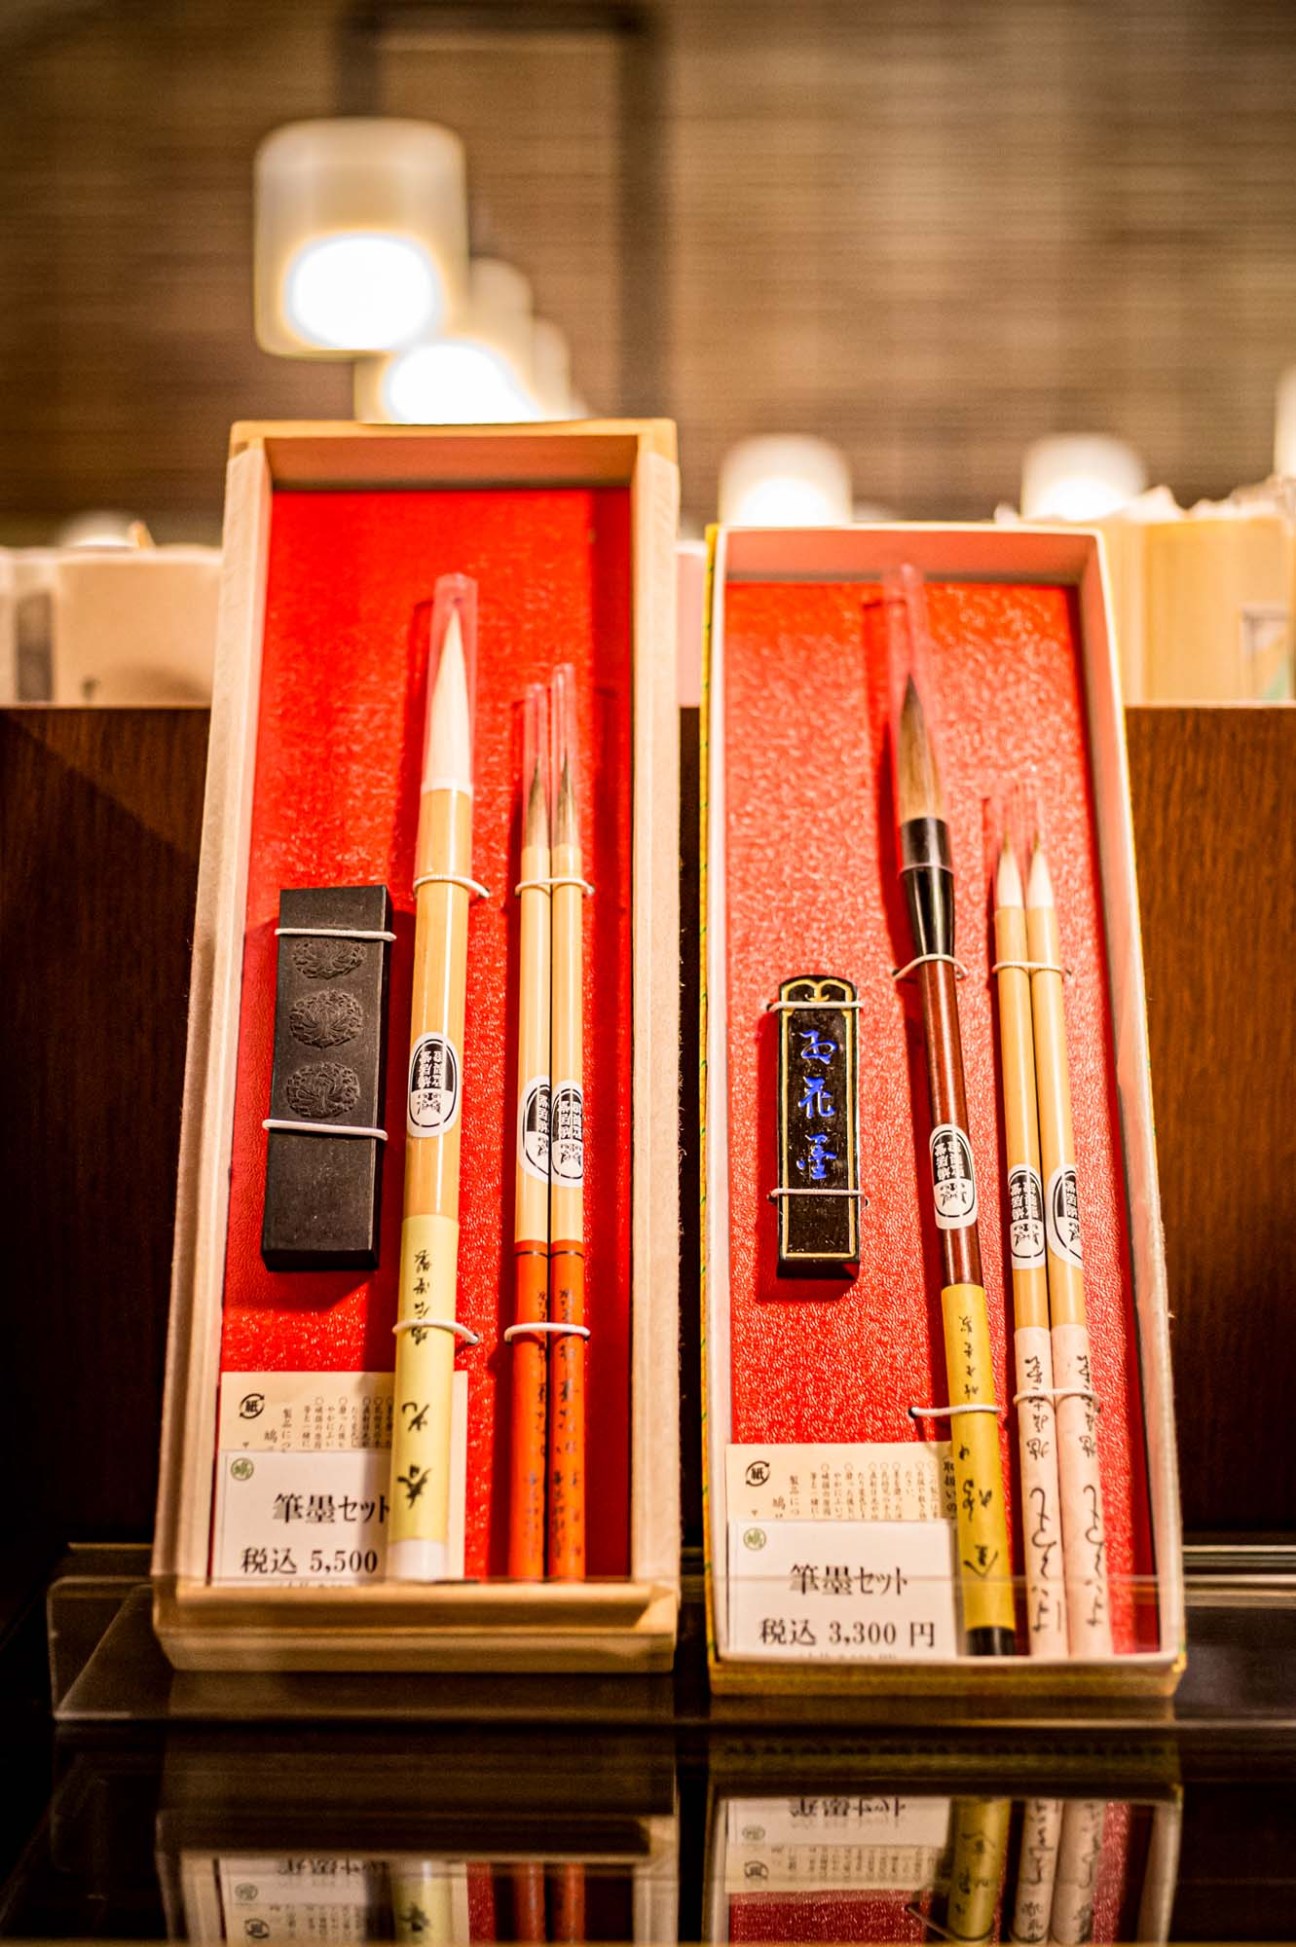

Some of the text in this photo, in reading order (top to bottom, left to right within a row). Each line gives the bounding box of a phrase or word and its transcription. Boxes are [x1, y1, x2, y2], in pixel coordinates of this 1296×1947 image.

[272, 1493, 390, 1523] 筆墨セット
[241, 1547, 378, 1574] 税込 5,500
[790, 1563, 908, 1596] 筆墨セット
[759, 1618, 935, 1648] 税込 3,300 円
